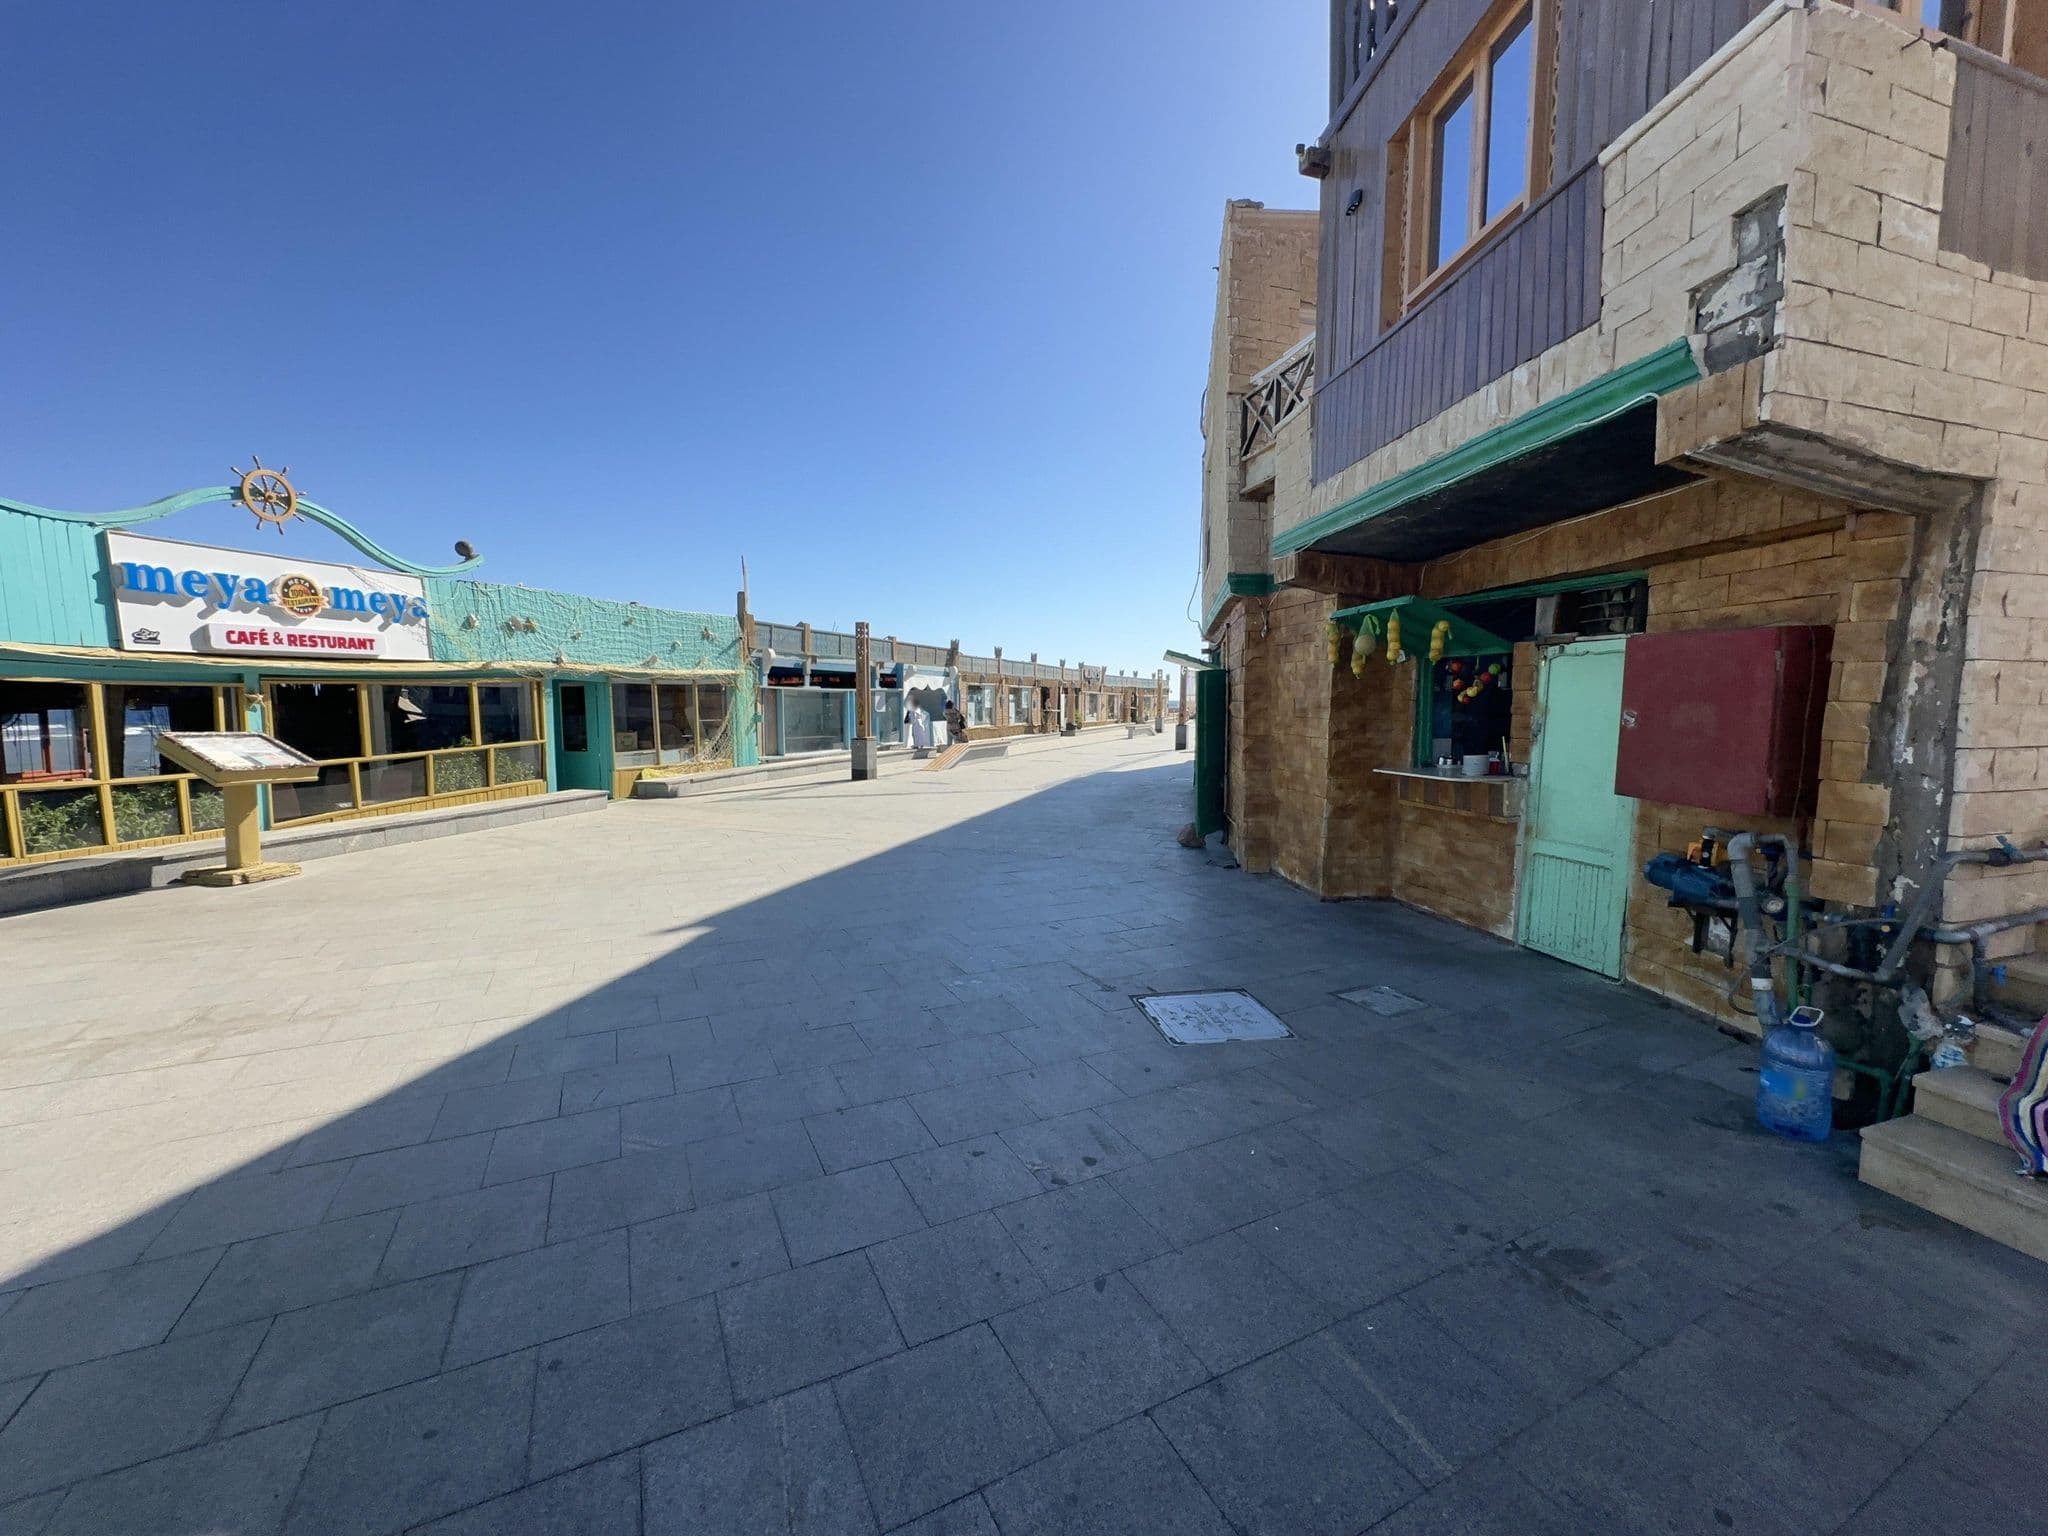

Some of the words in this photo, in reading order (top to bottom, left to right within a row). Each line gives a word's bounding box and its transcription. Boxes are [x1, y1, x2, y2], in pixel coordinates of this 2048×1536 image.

[121, 562, 271, 609] meya
[329, 586, 430, 623] meya
[287, 579, 310, 587] MEYA
[225, 628, 270, 646] CAFÉ
[272, 631, 284, 645] &
[287, 634, 375, 650] RESTURANT
